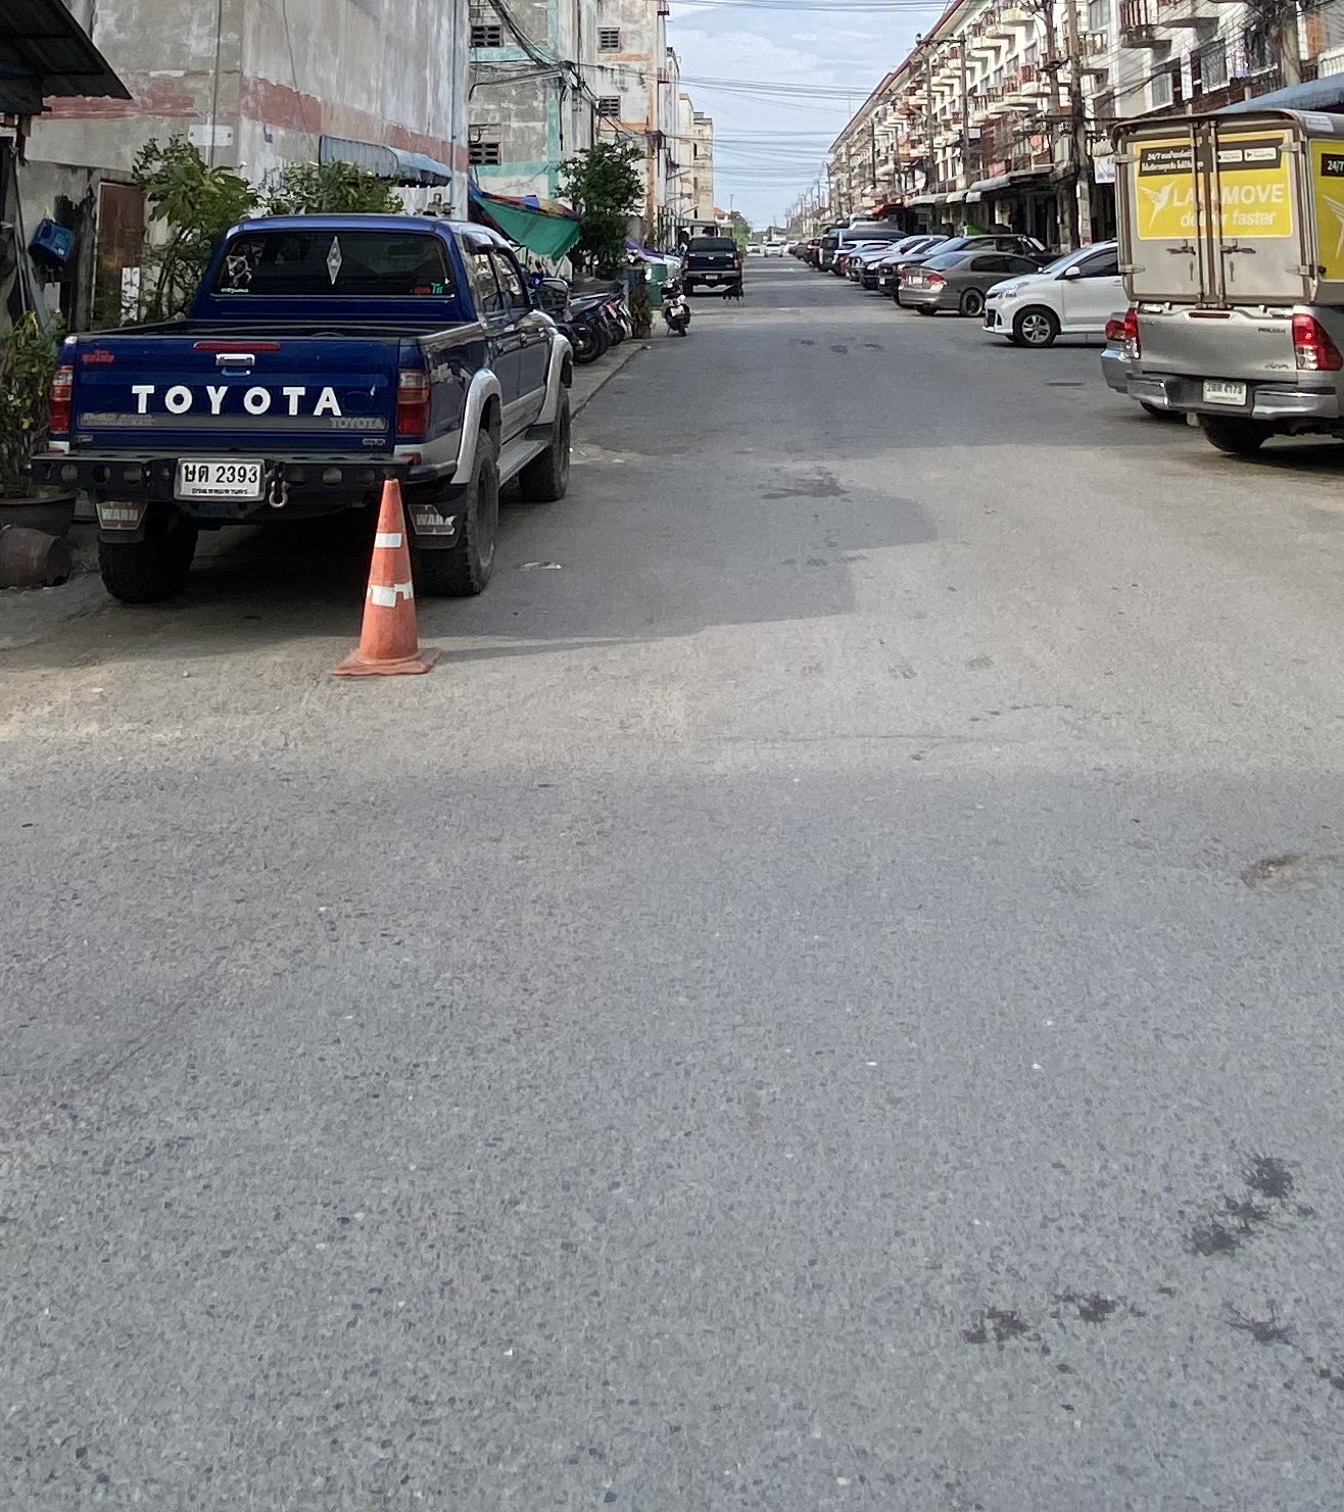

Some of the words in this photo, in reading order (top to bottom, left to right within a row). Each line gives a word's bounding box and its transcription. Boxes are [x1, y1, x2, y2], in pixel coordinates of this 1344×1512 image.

[1327, 160, 1344, 173] 24/7
[1233, 208, 1277, 227] faster
[132, 385, 342, 416] TOYOTA
[330, 417, 385, 430] TOYOTA
[216, 465, 258, 483] 2393
[101, 508, 138, 521] WARN
